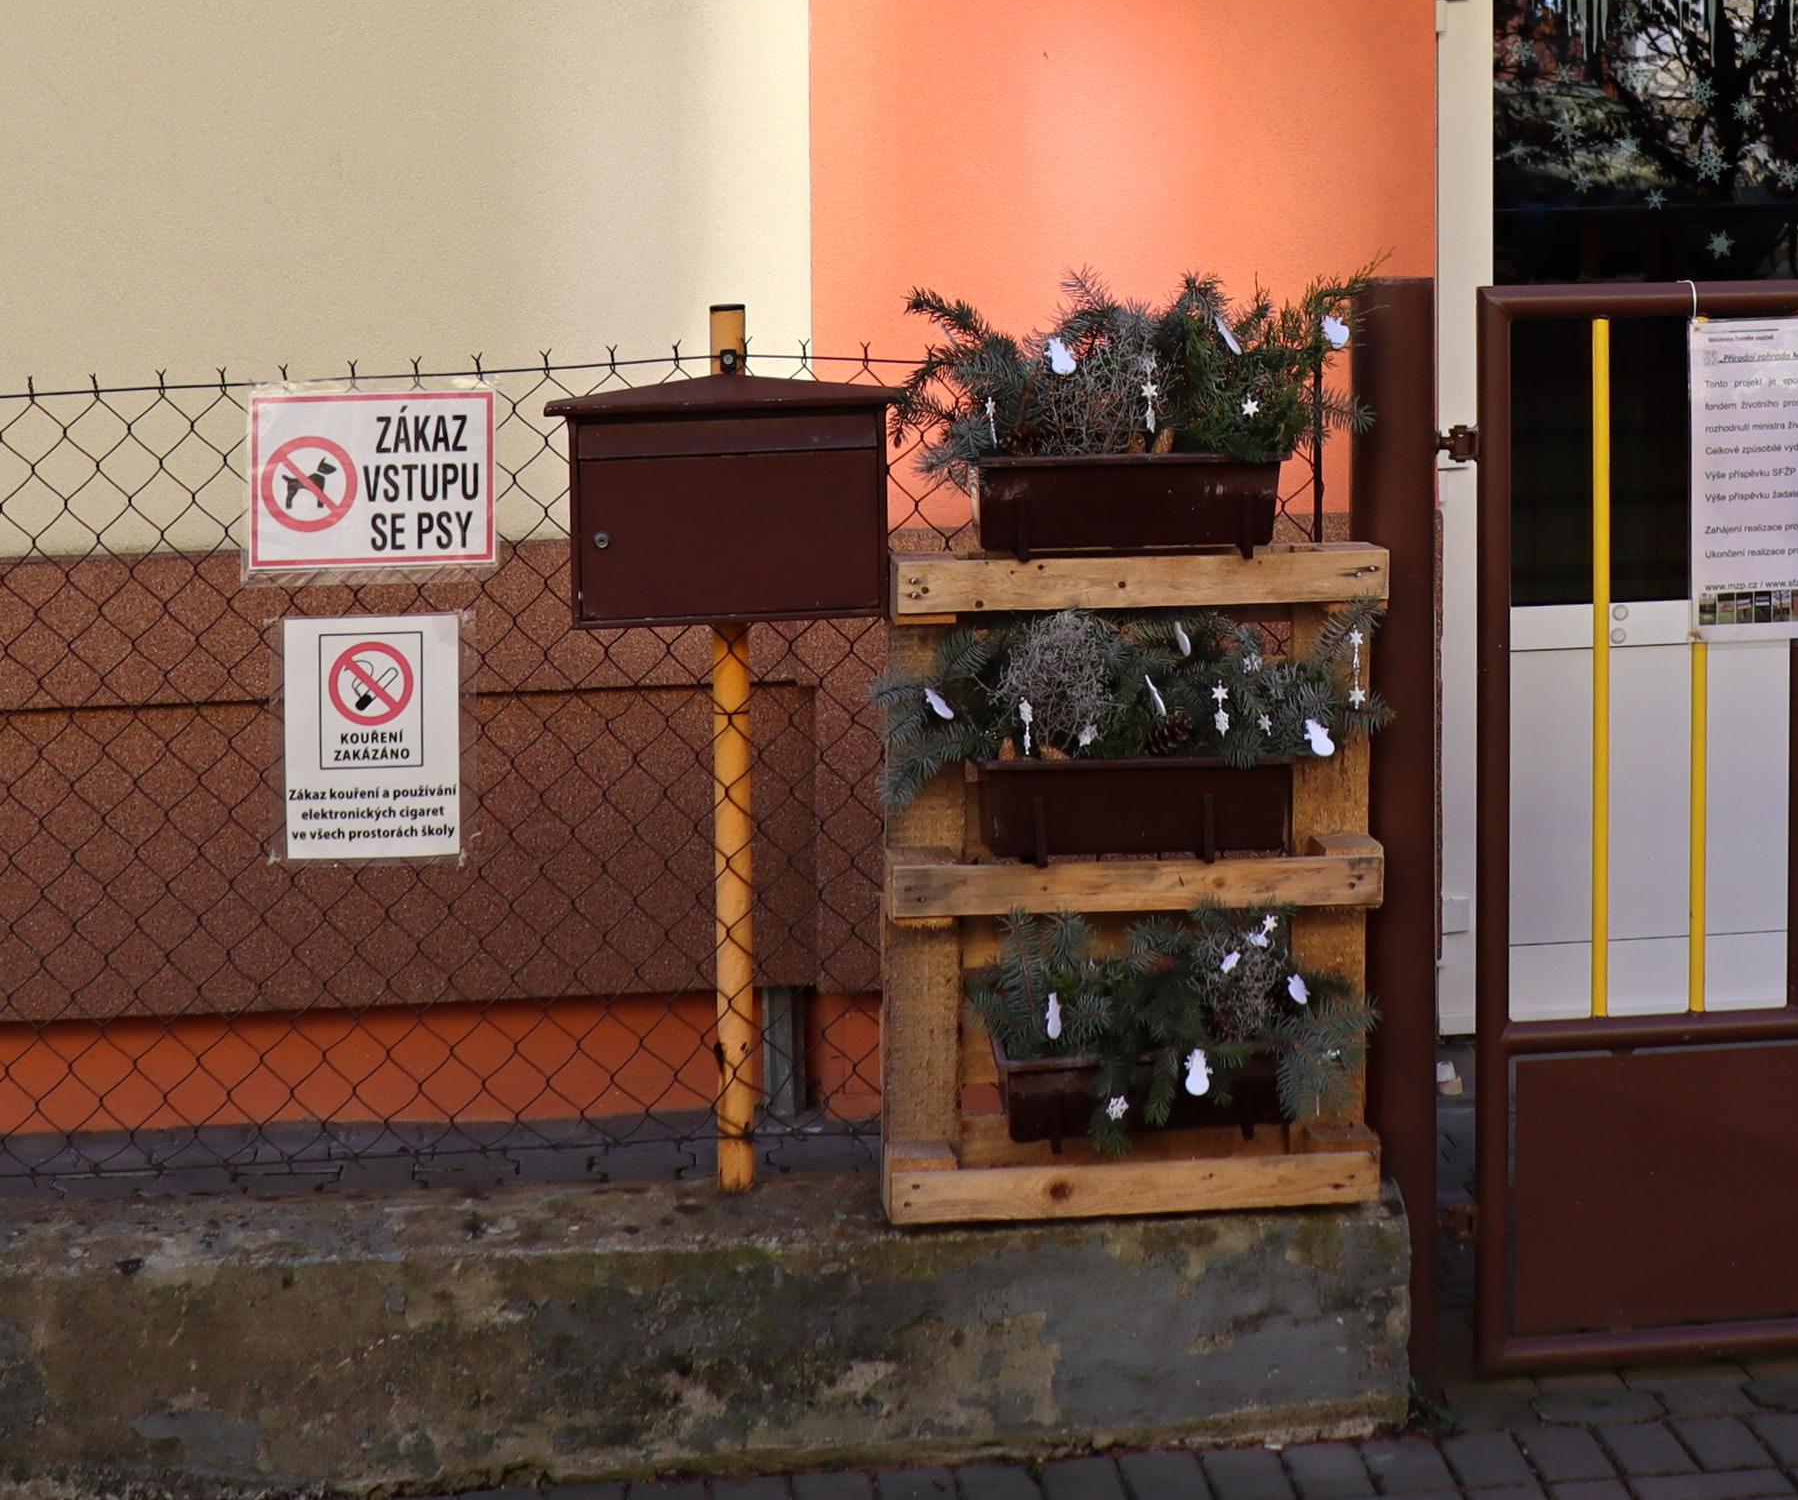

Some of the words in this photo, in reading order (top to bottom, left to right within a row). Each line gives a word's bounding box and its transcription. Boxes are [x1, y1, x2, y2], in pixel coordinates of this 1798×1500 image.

[1705, 380, 1728, 388] Tento
[1734, 379, 1763, 389] projekt
[1768, 378, 1776, 387] je
[1705, 402, 1736, 411] fondem
[1741, 399, 1779, 409] životního
[376, 406, 467, 453] ZÁKAZ
[1705, 423, 1750, 433] rozhodnutí
[1752, 422, 1785, 431] ministra
[1705, 446, 1739, 455] Celkové
[1742, 444, 1781, 454] způsobilé
[1705, 470, 1726, 480] Výše
[1729, 468, 1769, 479] příspěvku
[1772, 466, 1796, 476] SFŽP
[363, 463, 478, 502] VSTUPU
[1705, 493, 1726, 503] Výše
[1729, 491, 1769, 501] příspěvku
[371, 513, 405, 551] SE
[418, 511, 472, 549] PSY
[1705, 525, 1742, 535] Zahájení
[1745, 523, 1782, 533] realizace
[1705, 548, 1745, 559] Ukončení
[1747, 547, 1785, 557] realizace
[1705, 581, 1757, 592] www.mzp.cz
[341, 730, 402, 744] KOUŘENÍ
[334, 747, 409, 761] ZAKÁZÁNO
[289, 789, 326, 800] Zákaz
[330, 788, 379, 799] kouření
[383, 790, 389, 798] a
[393, 784, 456, 800] používání
[302, 807, 396, 821] elektronických
[400, 806, 444, 820] cigaret
[292, 832, 306, 840] ve
[310, 828, 345, 839] všech
[349, 826, 417, 841] prostorách
[422, 824, 454, 838] školy
